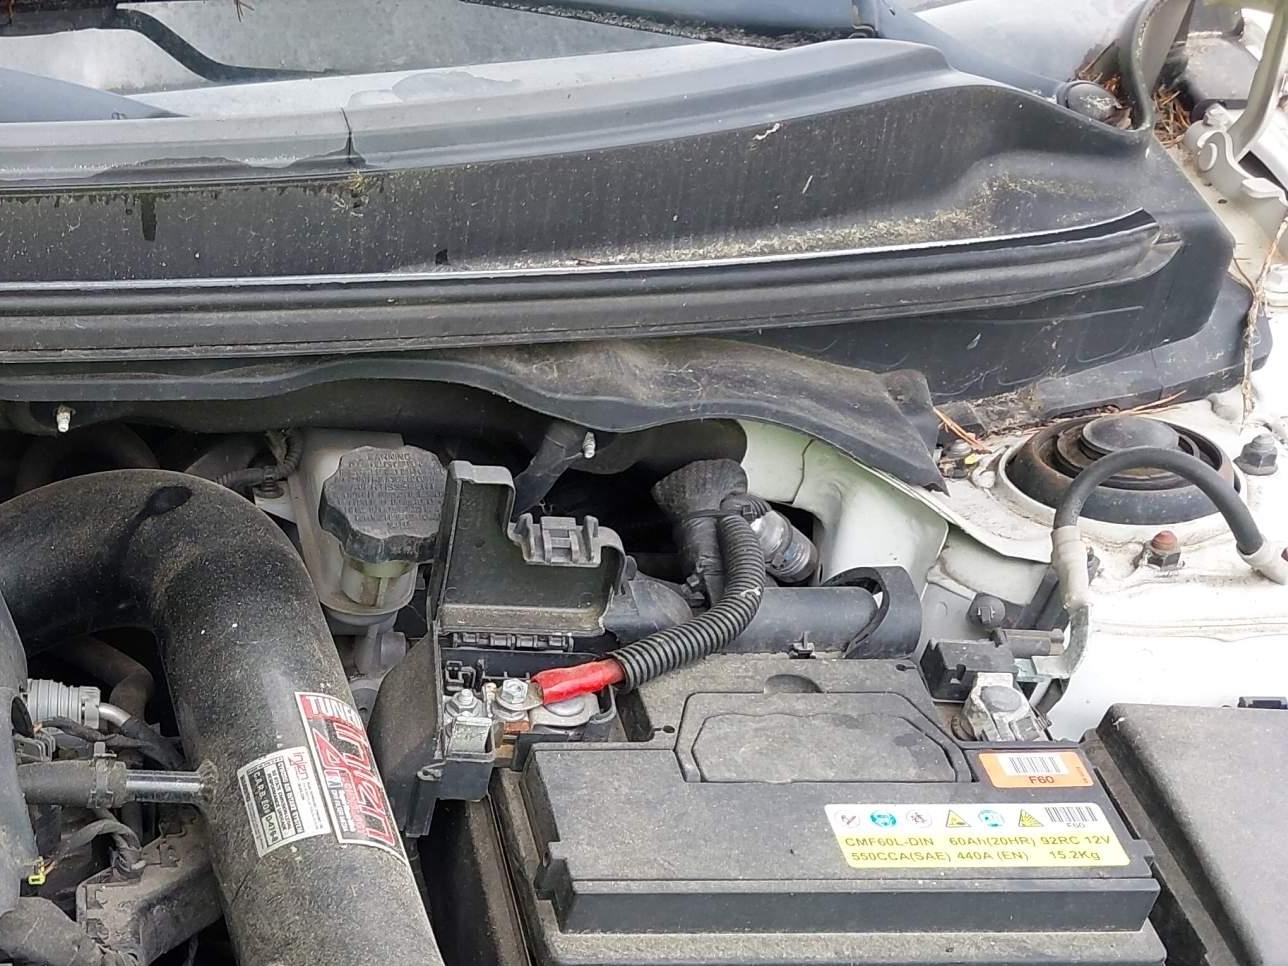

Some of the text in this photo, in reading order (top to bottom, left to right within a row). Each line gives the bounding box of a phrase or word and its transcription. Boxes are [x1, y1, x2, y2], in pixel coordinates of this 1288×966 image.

[1029, 775, 1055, 784] F60
[845, 835, 1110, 847] CMF60L-DIN 60Ah(20HR) 92RC 12V
[851, 851, 1101, 862] 550CCA(SAE) 440A (EN) 15.2Kg
